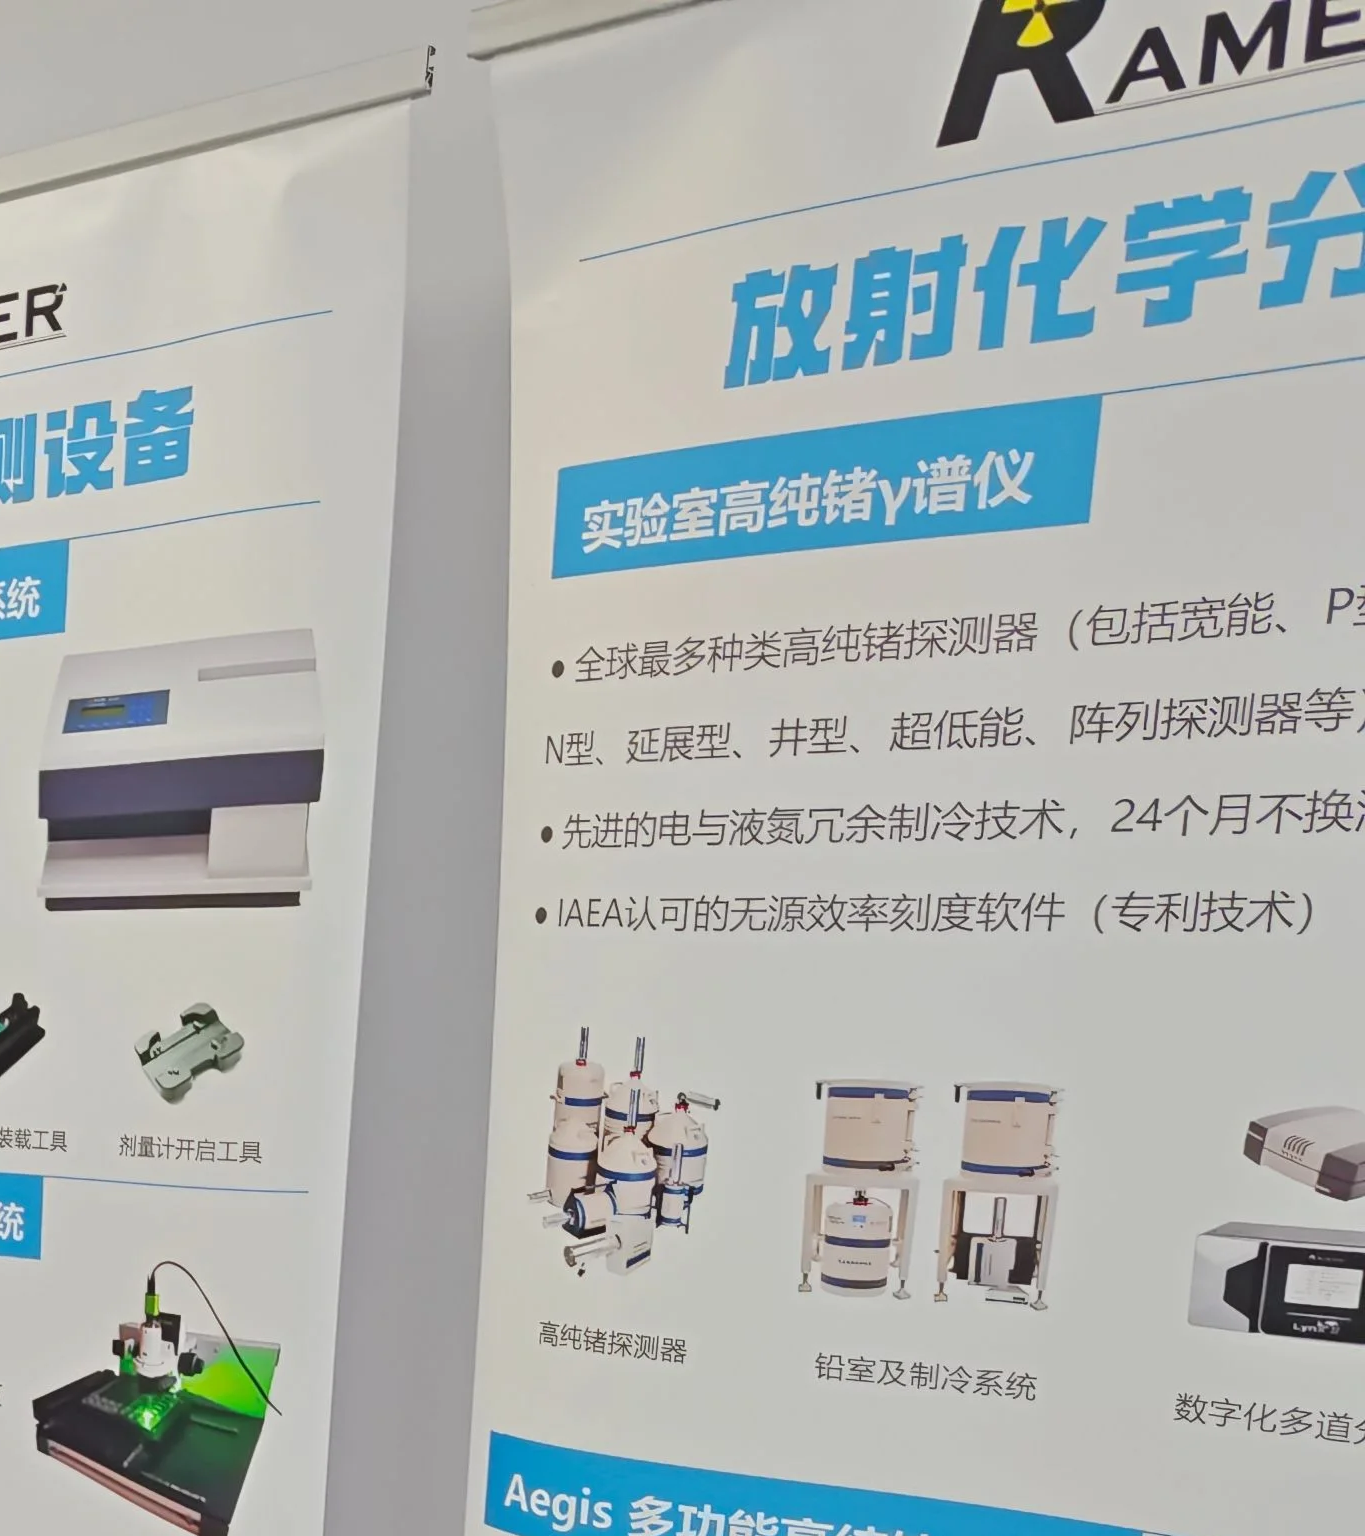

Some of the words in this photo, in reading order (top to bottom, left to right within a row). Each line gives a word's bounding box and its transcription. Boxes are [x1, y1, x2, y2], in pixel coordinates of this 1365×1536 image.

[723, 163, 1365, 390] 放射化学分
[580, 449, 1036, 555] 实验室高纯锗γ谱仪
[561, 788, 1365, 850] 先进的电与液氮冗余制冷技术，24个月不换
[557, 889, 1318, 936] IAEA认可的无源效率刻度软件（专利技术）
[118, 1134, 263, 1165] 剂量计开启工具
[538, 1320, 688, 1365] 高纯锗探测器
[815, 1353, 1038, 1402] 铅室及制冷系统
[504, 1472, 614, 1531] Aegis
